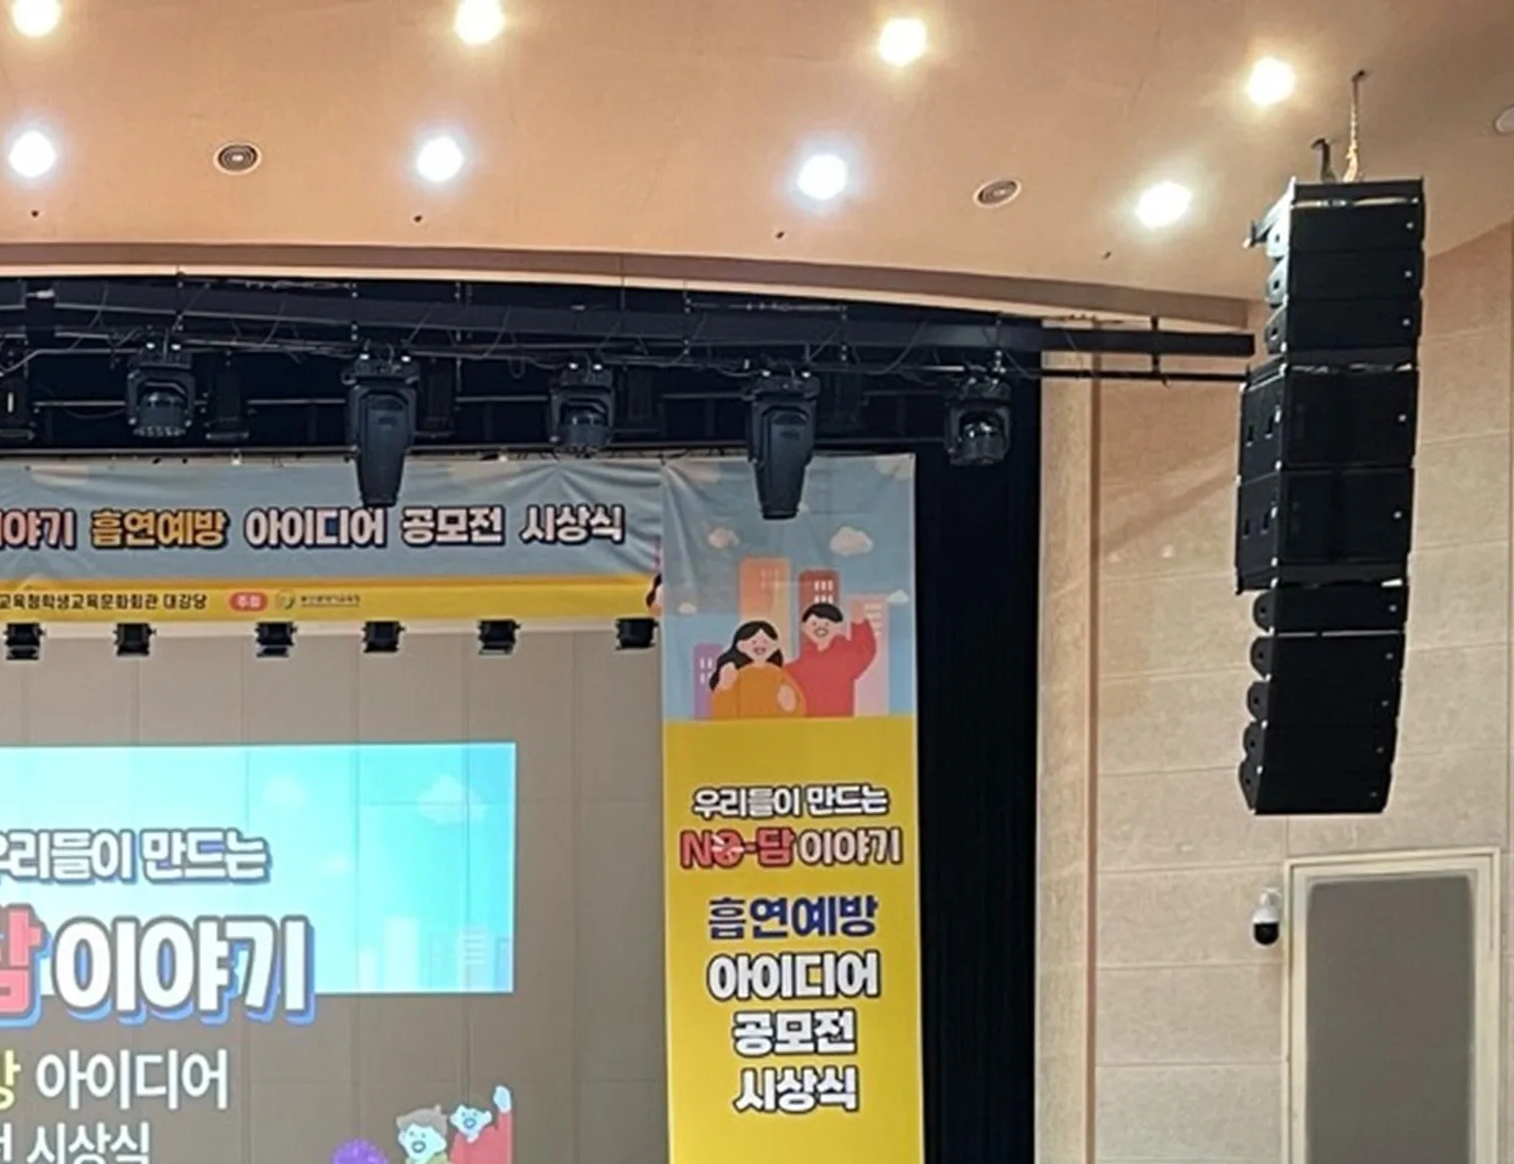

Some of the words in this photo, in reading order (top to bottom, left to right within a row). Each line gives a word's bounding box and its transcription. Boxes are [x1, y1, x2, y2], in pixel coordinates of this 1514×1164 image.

[244, 505, 386, 548] 아이디어
[401, 504, 503, 547] 공모전
[519, 503, 626, 545] 시상식
[163, 593, 206, 611] 대강당
[692, 785, 802, 820] 우리들이
[806, 782, 890, 818] 만드는
[141, 829, 271, 884] 만드는
[707, 949, 880, 1001] 아이디어
[732, 1008, 857, 1058] 공모전
[36, 1049, 228, 1111] 아이디어
[733, 1065, 860, 1114] 시상식
